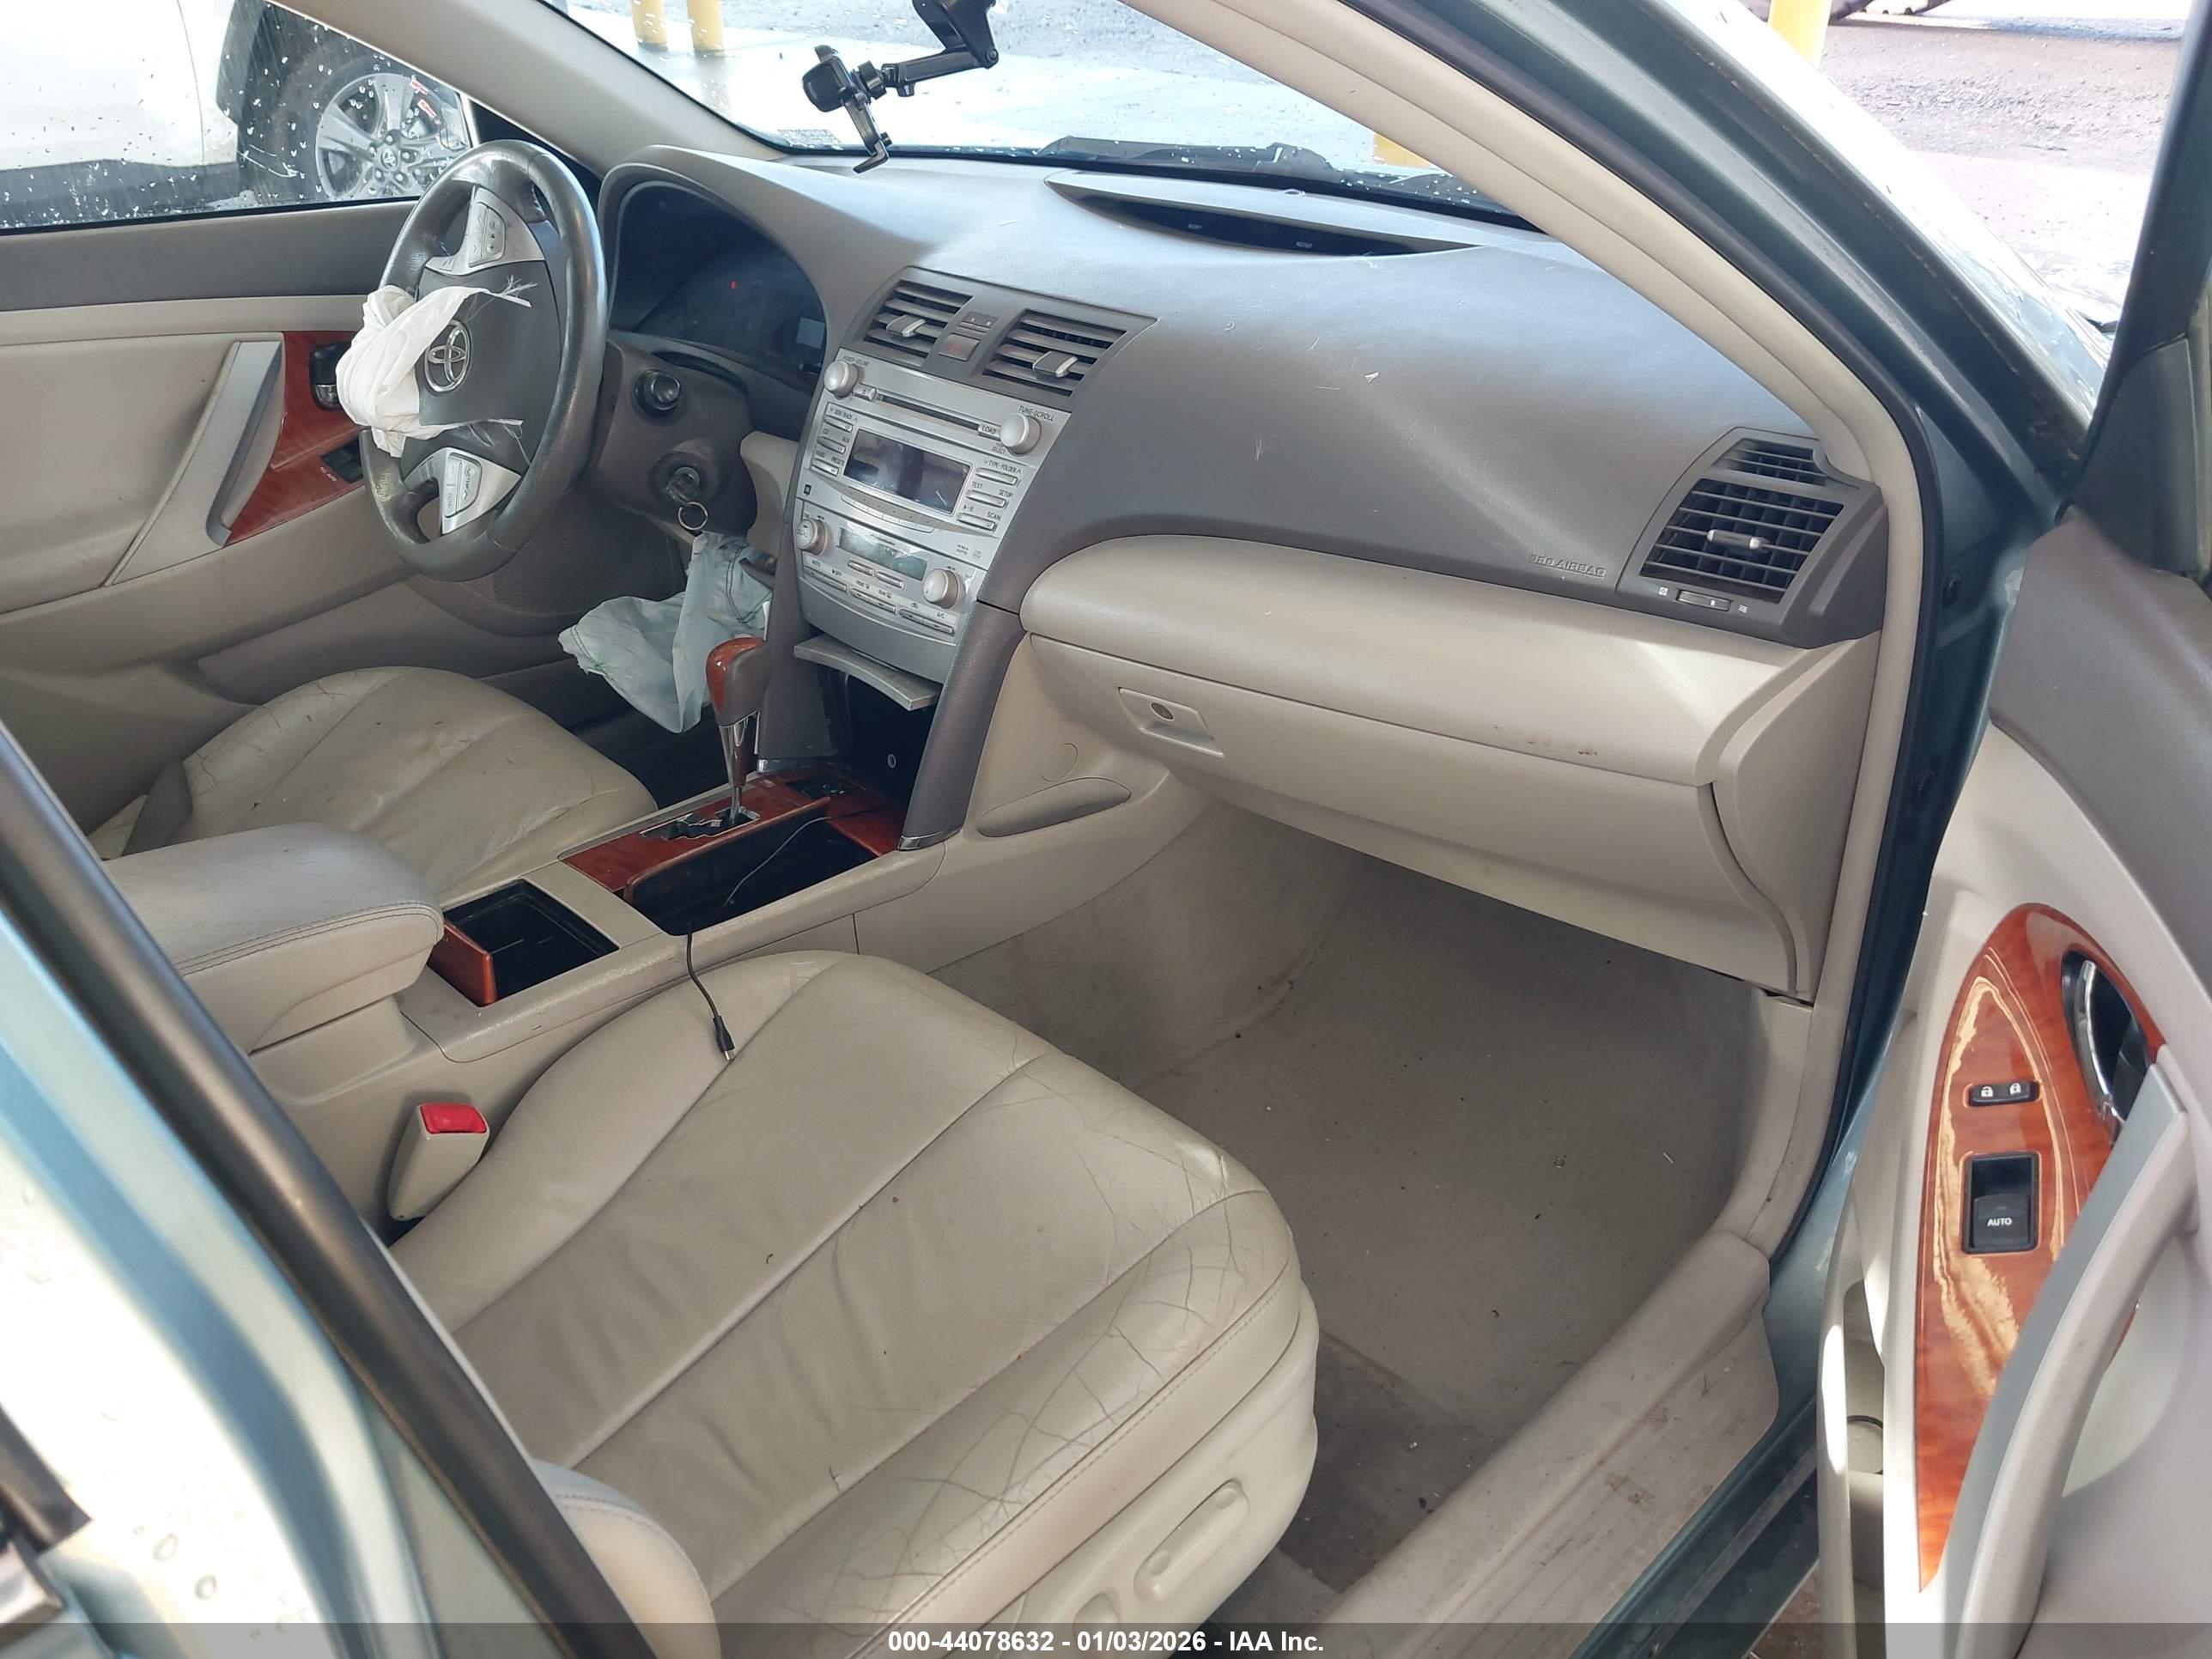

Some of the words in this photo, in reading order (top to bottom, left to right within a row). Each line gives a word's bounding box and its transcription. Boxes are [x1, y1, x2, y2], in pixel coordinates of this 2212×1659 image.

[981, 424, 997, 434] LOAD
[971, 481, 983, 489] TEXT
[998, 489, 1014, 498] SETUP
[987, 511, 1001, 521] SCAN
[1555, 559, 1607, 578] AIRBAG
[1986, 1217, 2013, 1227] AUTO
